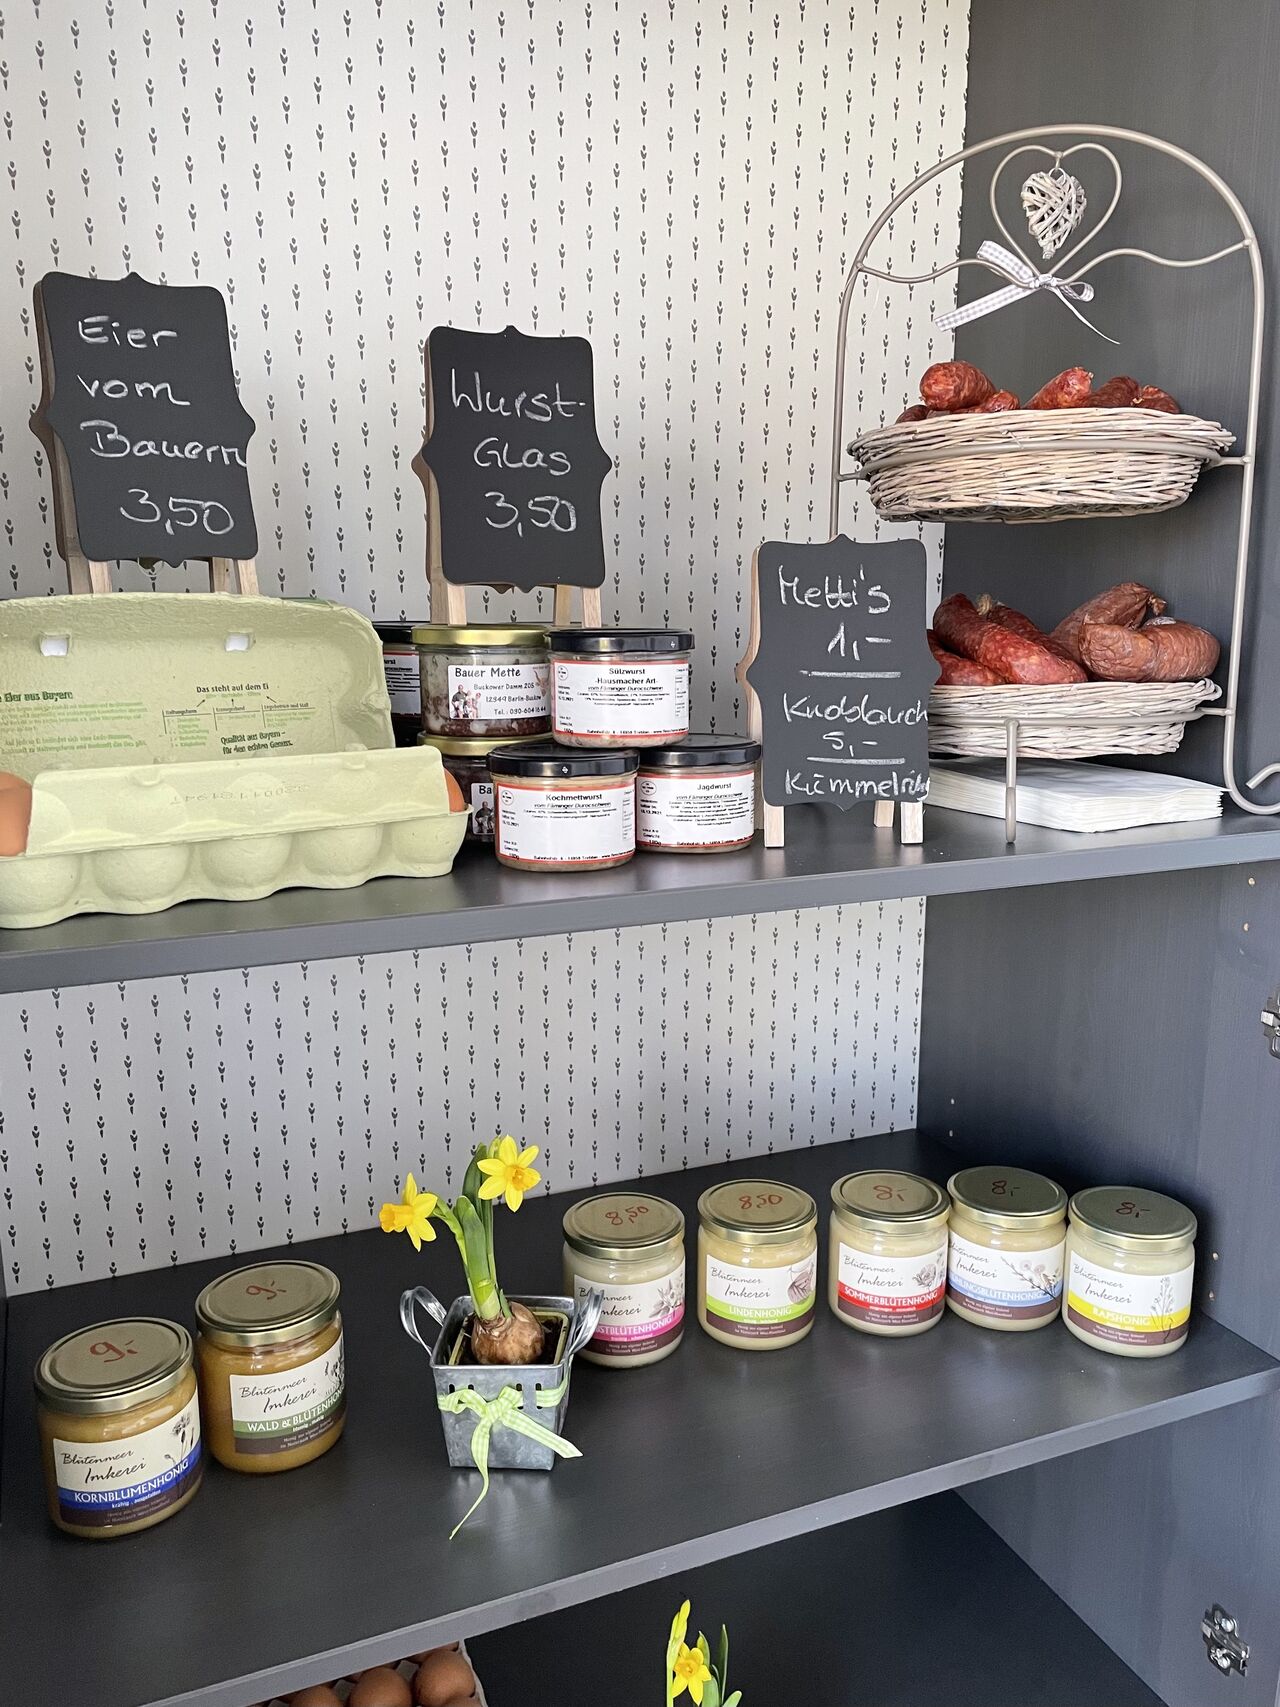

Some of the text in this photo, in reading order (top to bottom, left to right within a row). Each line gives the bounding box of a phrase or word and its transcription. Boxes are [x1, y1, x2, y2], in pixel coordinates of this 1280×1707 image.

[78, 315, 178, 349] Eier
[77, 374, 191, 406] vom
[80, 419, 248, 468] Bauern
[120, 488, 235, 535] 3,50
[485, 491, 577, 537] 3,50
[778, 564, 892, 614] Metti's
[827, 622, 892, 661] 1,-
[455, 667, 521, 677] Bauer Mette
[24, 692, 41, 701] aus
[211, 684, 230, 692] steht
[231, 683, 243, 692] auf
[245, 683, 261, 691] dem
[263, 682, 269, 690] Ei
[486, 695, 507, 703] 12349
[783, 693, 929, 725] Knoblauch
[823, 731, 879, 757] 5,-
[545, 793, 603, 802] Kochmettwurst
[697, 783, 732, 791] Jagdwurst
[606, 1206, 648, 1226] 8,50
[843, 1255, 895, 1273] Blütenmeer
[956, 1258, 998, 1279] Imkerei
[711, 1266, 761, 1284] Blütenmeer
[857, 1272, 903, 1287] Imkerei
[1073, 1263, 1125, 1289] Blütenmeer
[724, 1284, 771, 1298] Imkerei
[844, 1286, 938, 1306] SOMMERBLÜTENHONIG
[1085, 1283, 1133, 1304] Imkerei
[600, 1303, 642, 1317] mkerei
[729, 1305, 792, 1318] LINDENHONIG
[239, 1376, 307, 1399] Blütenmeer
[263, 1383, 317, 1413] Imkerei
[247, 1420, 281, 1432] WALD
[282, 1418, 291, 1427] &
[293, 1390, 342, 1426] BLÜTENHON
[61, 1450, 134, 1465] Blütenmeer
[74, 1459, 189, 1503] KORNBLUMENHONIG
[84, 1457, 147, 1484] Imkerei
